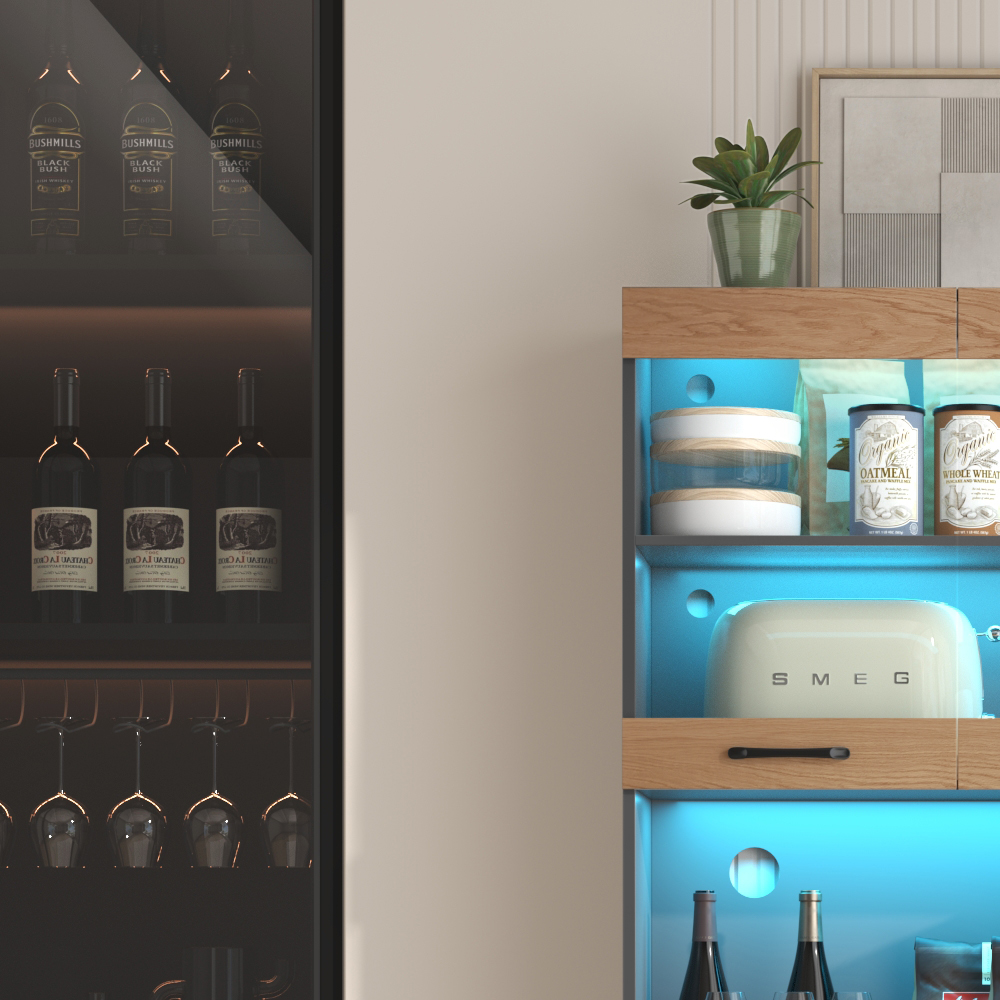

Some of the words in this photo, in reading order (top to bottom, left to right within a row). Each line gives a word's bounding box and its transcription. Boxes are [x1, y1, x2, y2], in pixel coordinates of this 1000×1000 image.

[29, 138, 81, 149] BUSHMILLS
[122, 138, 174, 149] BUSHMILLS
[210, 138, 263, 149] BUSHMILLS
[859, 429, 909, 466] Organic
[944, 429, 995, 466] Organic
[860, 467, 911, 479] OATMEAL
[943, 469, 971, 479] WHOLE
[973, 469, 1000, 479] WHEAT
[772, 671, 909, 686] SMEG
